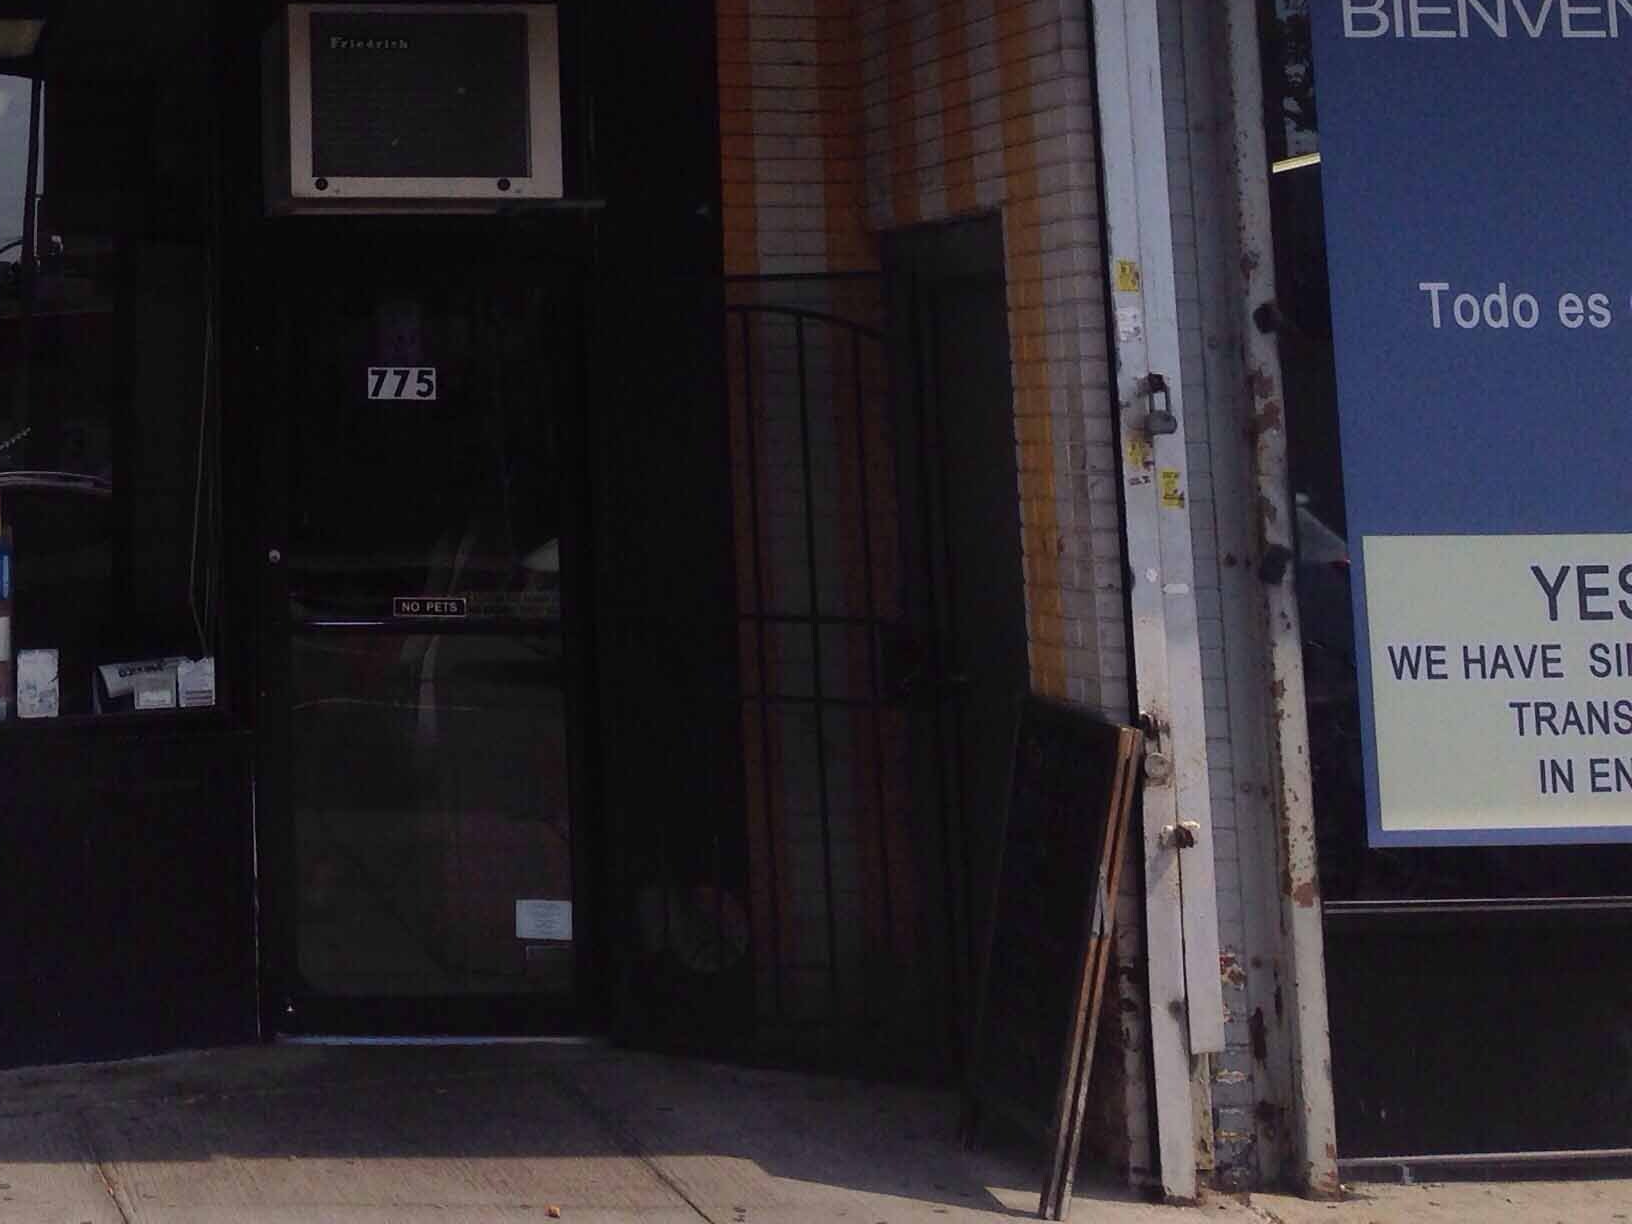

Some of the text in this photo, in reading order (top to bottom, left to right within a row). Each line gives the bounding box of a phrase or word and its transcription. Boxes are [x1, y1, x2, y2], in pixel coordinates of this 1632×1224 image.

[330, 35, 409, 49] Friedrich
[1418, 282, 1540, 329] Todo
[1558, 291, 1613, 329] es
[369, 369, 435, 398] 775
[400, 601, 458, 613] NO PETS
[1387, 641, 1632, 681] WE HAVE SI
[1508, 698, 1632, 737] TRANS
[1538, 756, 1632, 794] IN EN
